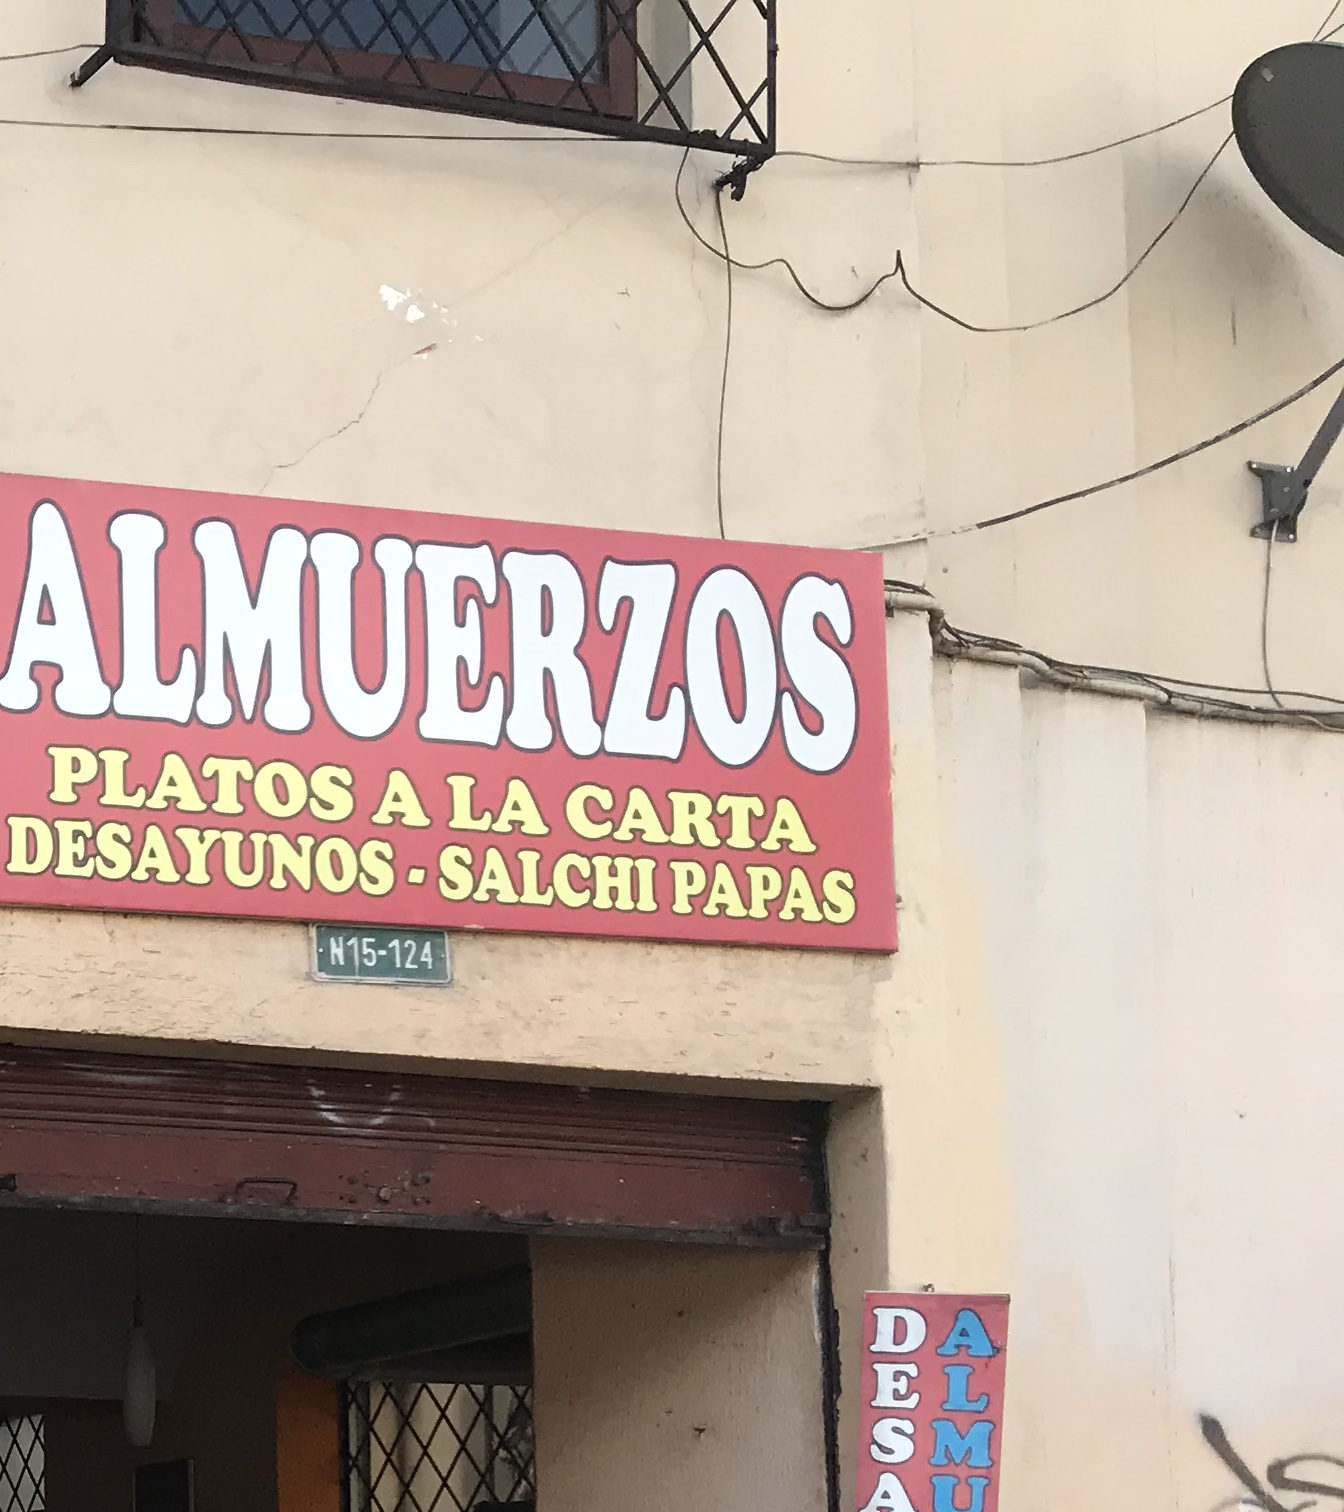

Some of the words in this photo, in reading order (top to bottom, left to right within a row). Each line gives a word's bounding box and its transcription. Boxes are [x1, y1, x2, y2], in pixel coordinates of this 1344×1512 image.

[46, 744, 355, 822] PLATOS
[371, 769, 431, 828] A
[445, 773, 550, 837] LA
[564, 783, 817, 853] CARTA
[6, 815, 396, 896] DESAYUNOS
[438, 845, 658, 912] SALCHI
[668, 859, 857, 925] PAPAS
[330, 936, 434, 970] N15-124
